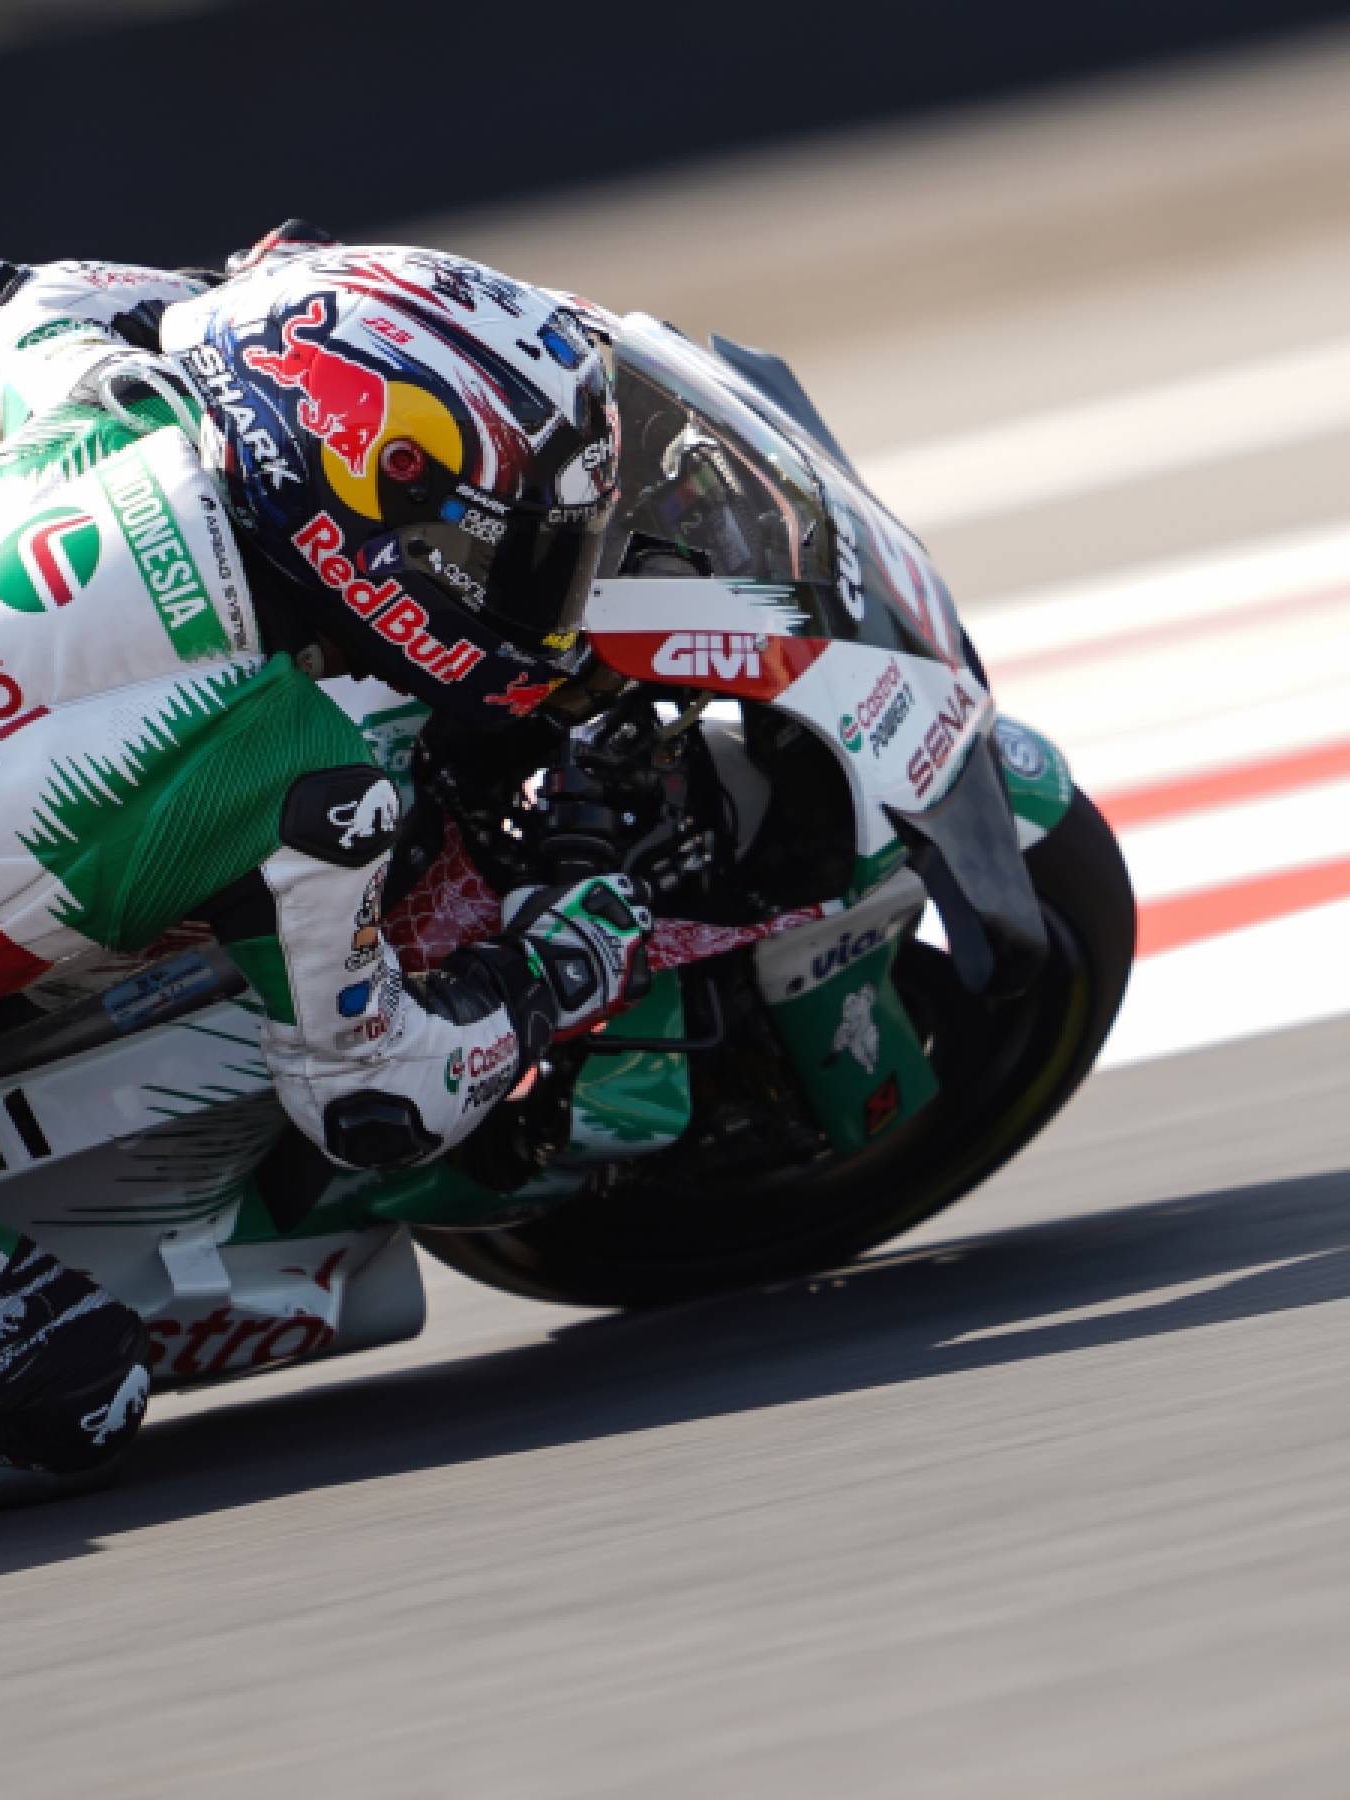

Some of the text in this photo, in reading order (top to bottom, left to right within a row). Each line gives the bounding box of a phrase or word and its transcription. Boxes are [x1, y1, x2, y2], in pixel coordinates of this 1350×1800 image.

[192, 345, 302, 489] SHARK
[108, 468, 206, 627] DONESIA
[292, 512, 486, 683] Red Bull
[653, 633, 761, 680] GIVI
[856, 657, 900, 729] Castrol
[906, 685, 976, 798] SENA
